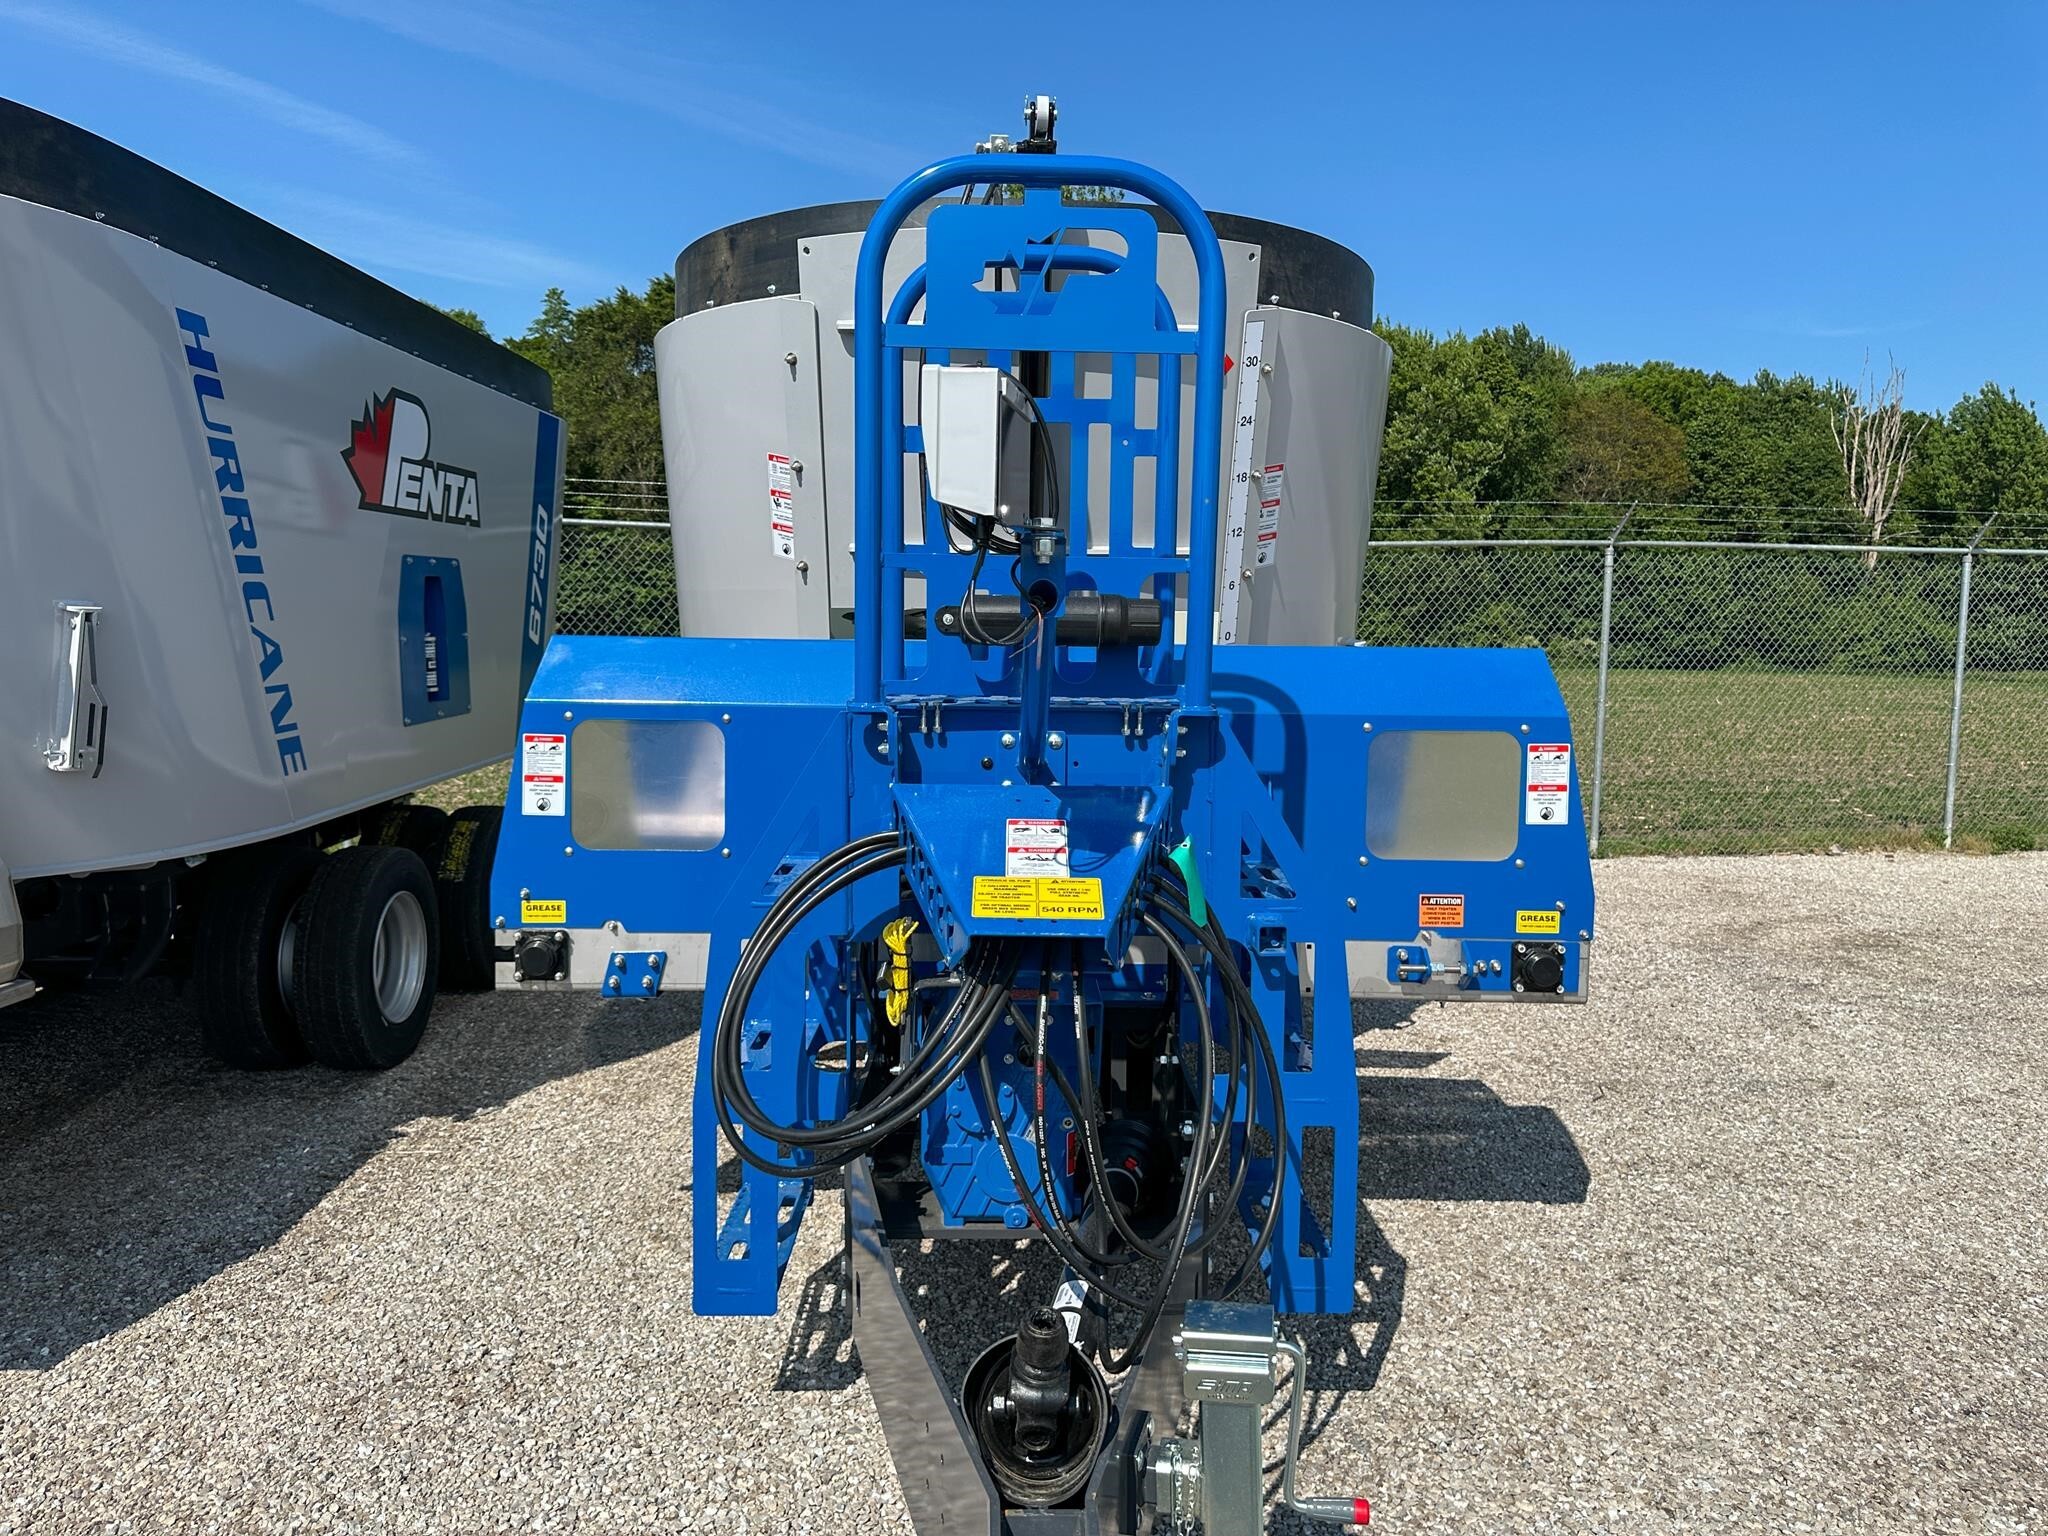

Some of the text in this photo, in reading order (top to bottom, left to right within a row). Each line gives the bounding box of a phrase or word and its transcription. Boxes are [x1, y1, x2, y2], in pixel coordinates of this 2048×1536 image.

[1246, 356, 1258, 367] 30
[1240, 415, 1252, 426] 24
[382, 396, 480, 523] PENTA
[1236, 472, 1247, 483] 18
[1231, 527, 1242, 538] 12
[175, 307, 307, 777] HURRICANE
[529, 503, 548, 645] 6730
[1228, 580, 1235, 590] 6
[1224, 631, 1231, 641] 0
[1429, 897, 1461, 905] ATTENTION
[526, 904, 562, 912] GREASE
